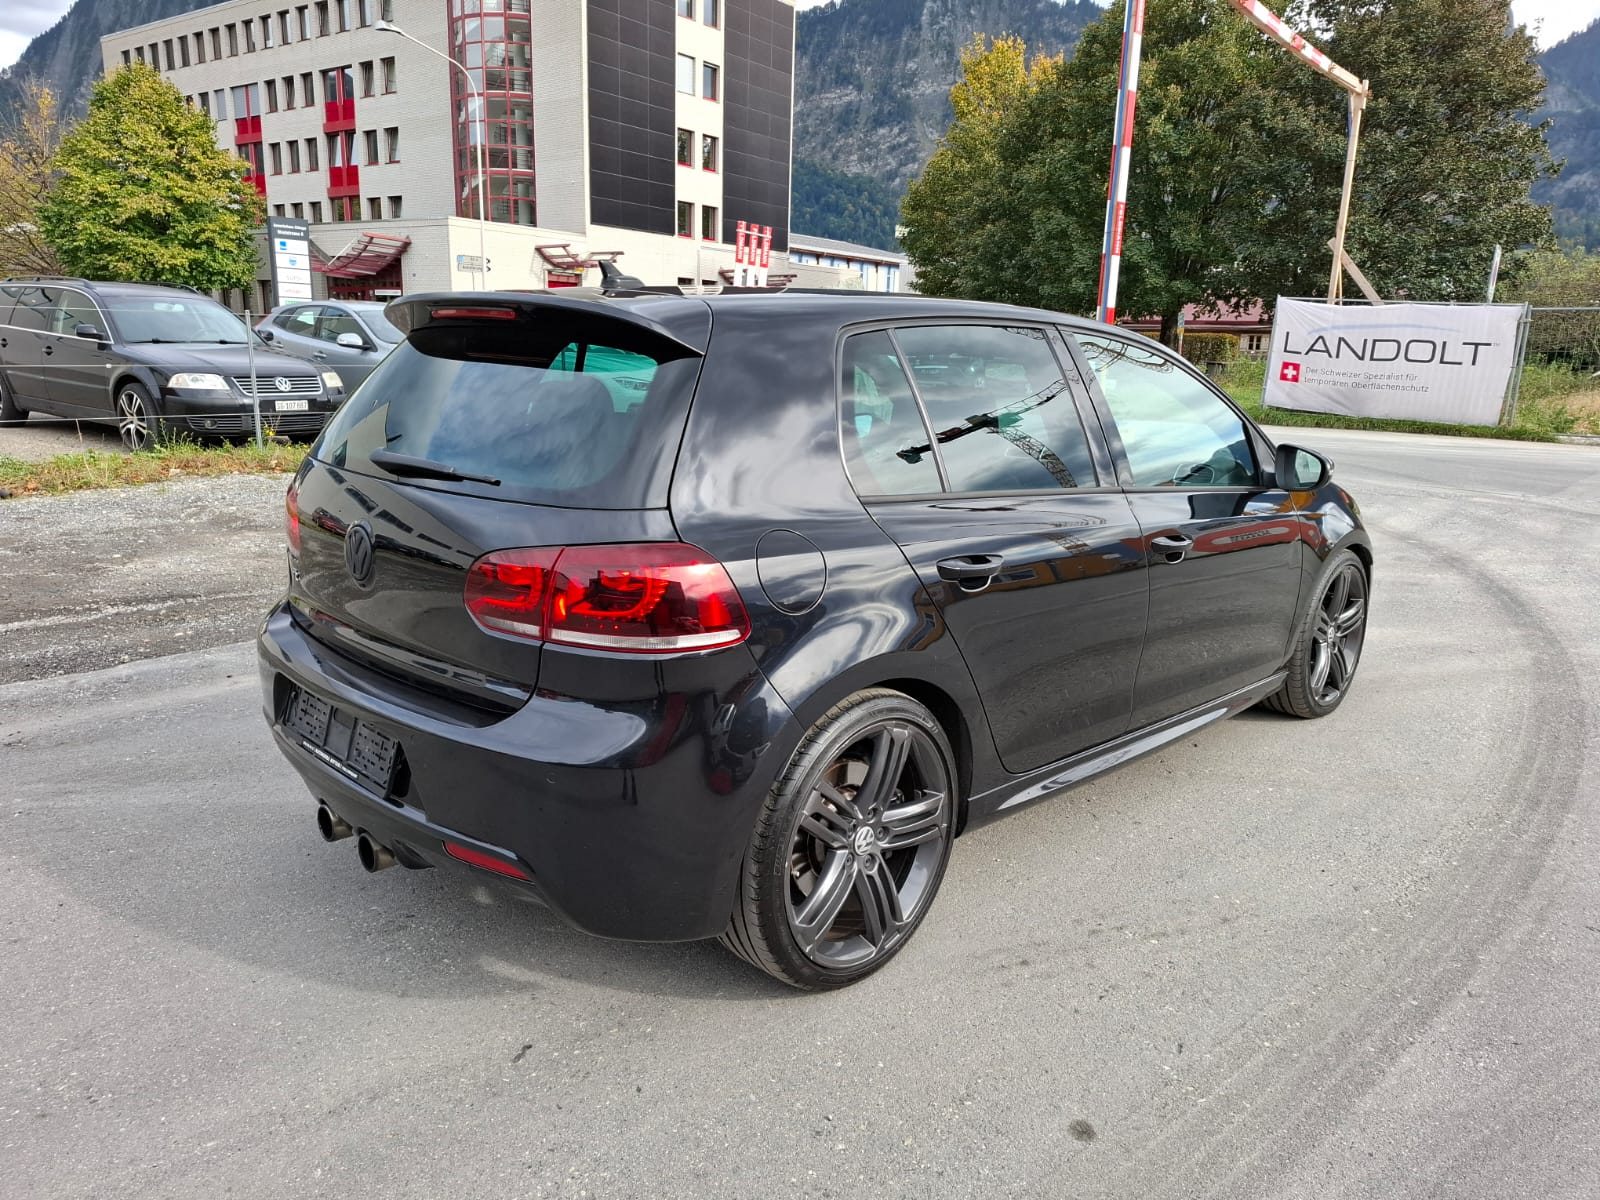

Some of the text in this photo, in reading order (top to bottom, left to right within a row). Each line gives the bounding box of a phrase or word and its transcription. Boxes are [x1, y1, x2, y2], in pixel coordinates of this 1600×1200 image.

[1283, 331, 1492, 366] LANDOLT
[1305, 366, 1418, 381] Der Schweizer Spezialist für
[1351, 381, 1430, 393] Oberflächenschutz
